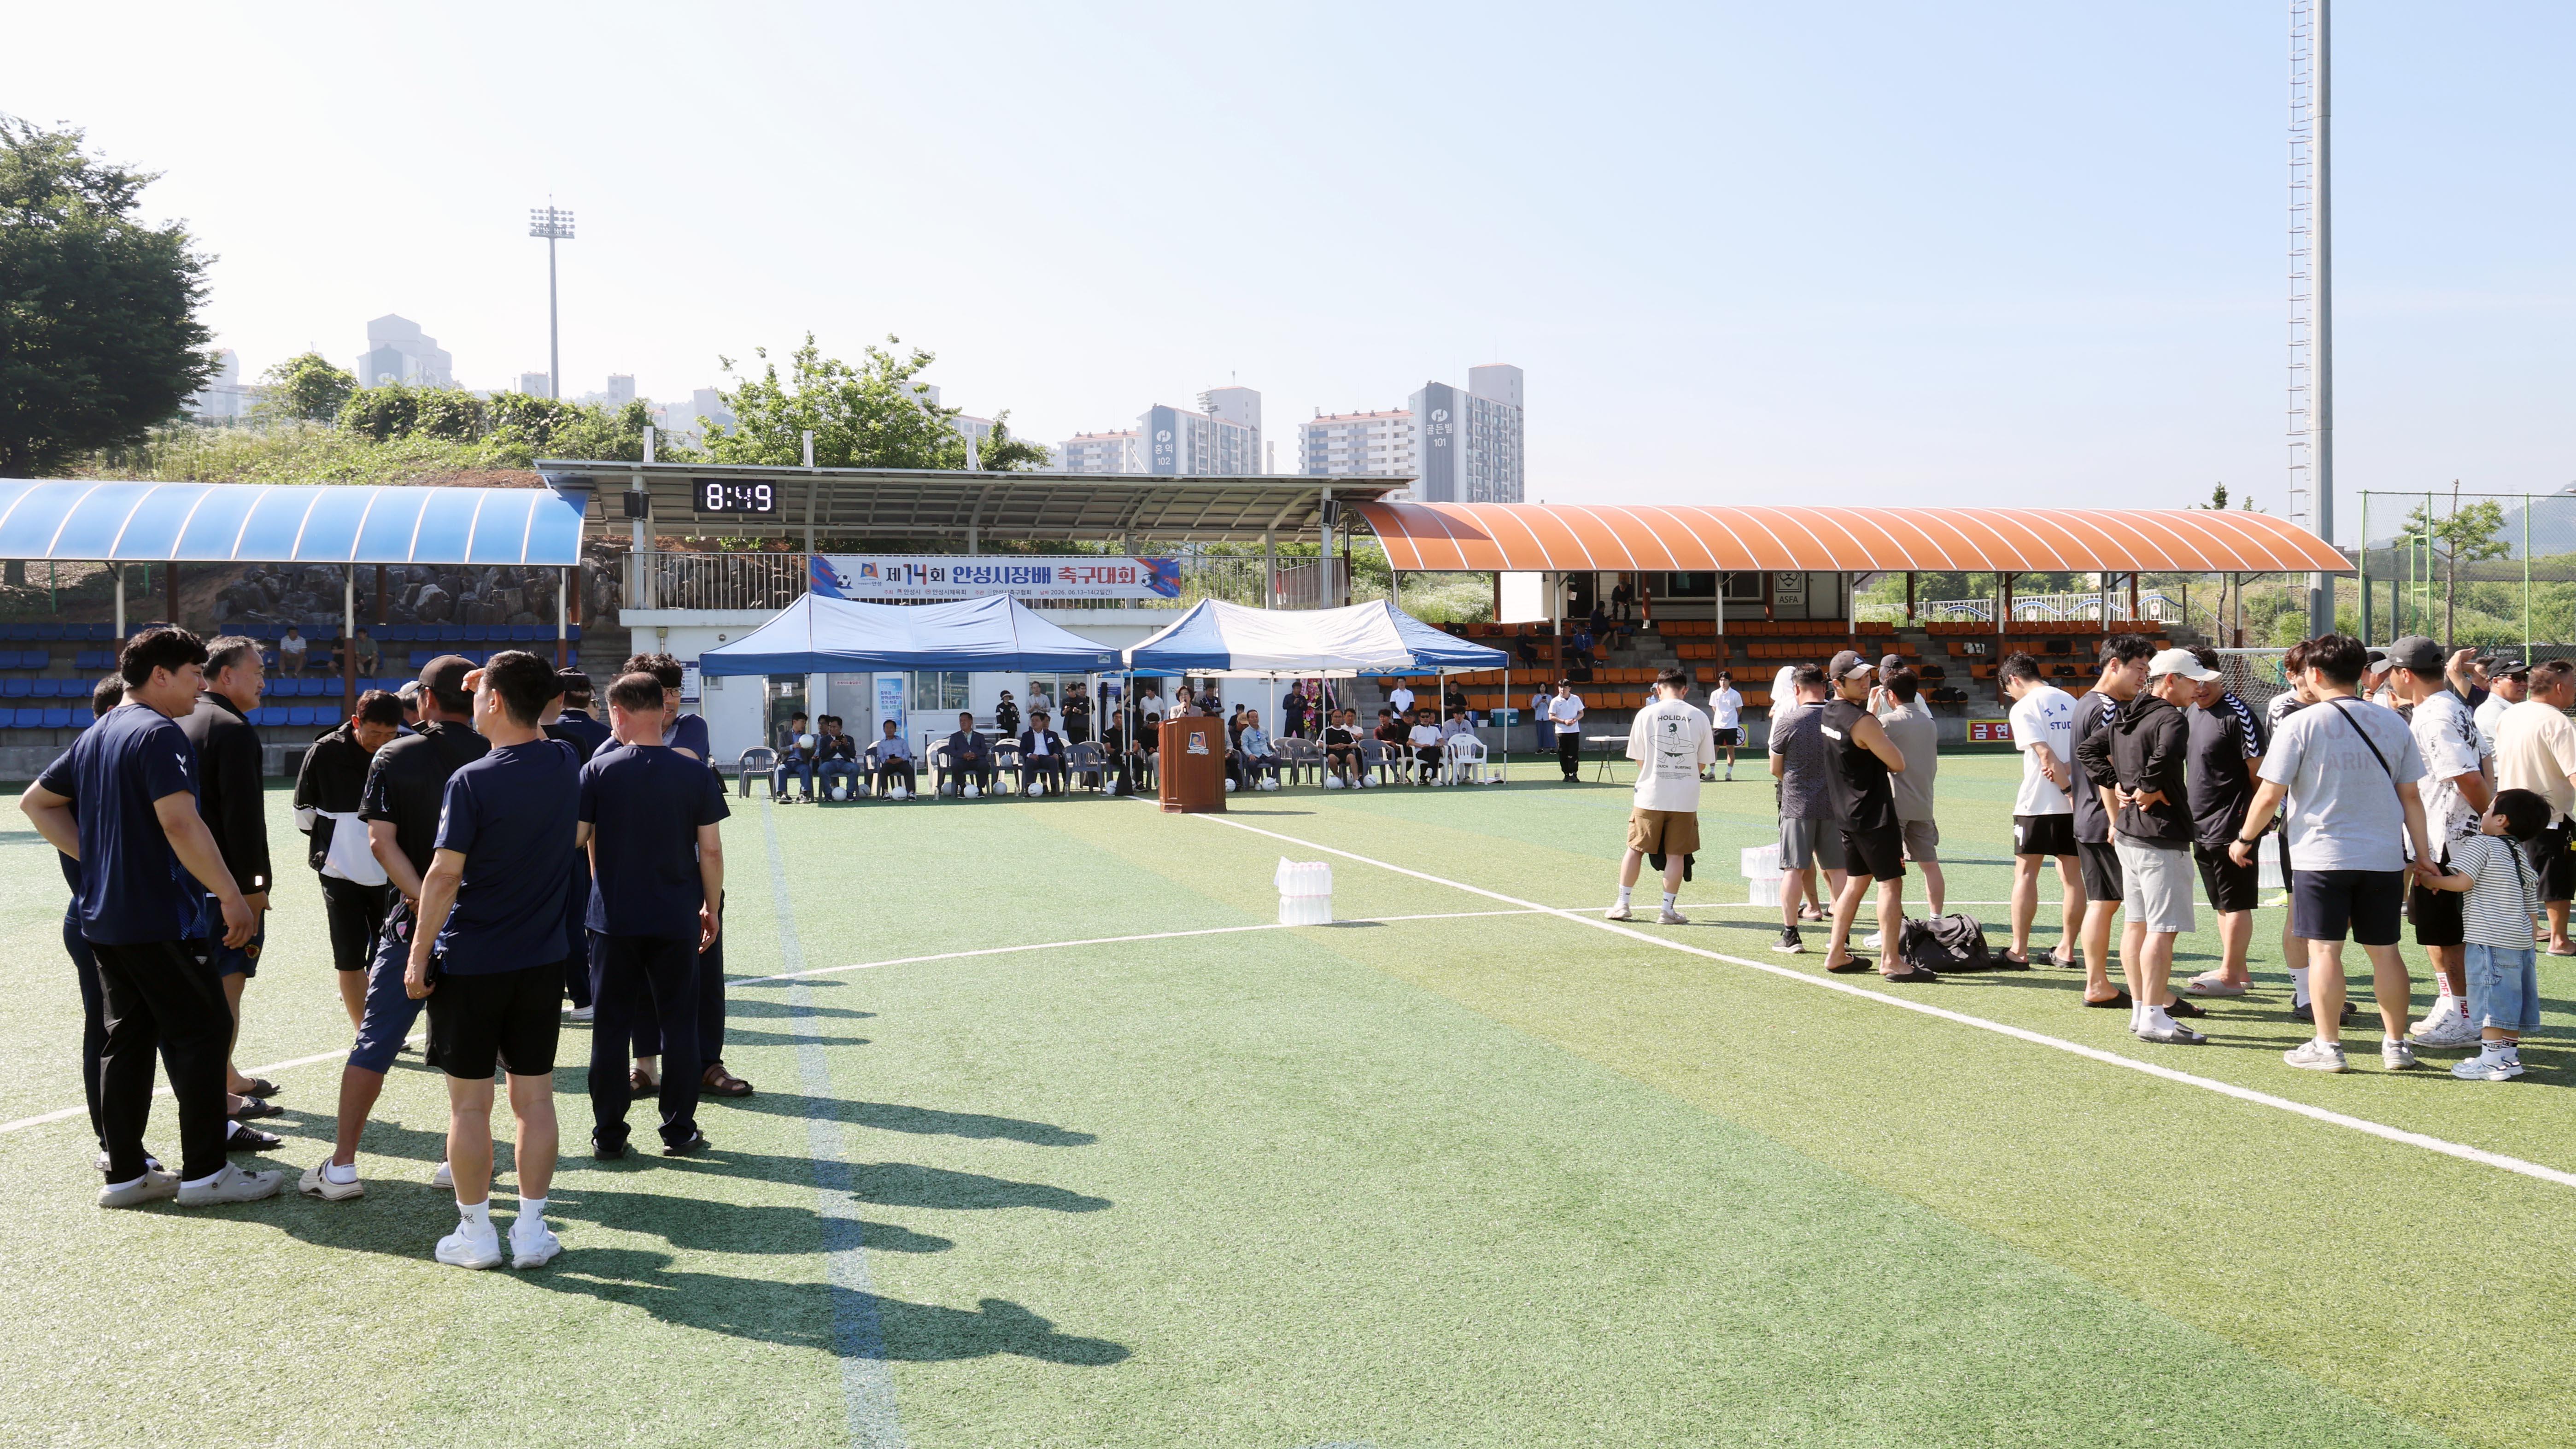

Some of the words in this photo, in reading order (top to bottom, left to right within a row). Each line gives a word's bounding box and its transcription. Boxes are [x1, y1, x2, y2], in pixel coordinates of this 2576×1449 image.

[1427, 423, 1452, 435] 골든빌
[1434, 438, 1446, 447] 101
[1158, 457, 1171, 465] 102
[707, 484, 771, 510] 8:49
[886, 564, 944, 585] 제14회
[953, 566, 1051, 584] 안성시장배
[1058, 567, 1135, 584] 축구대회
